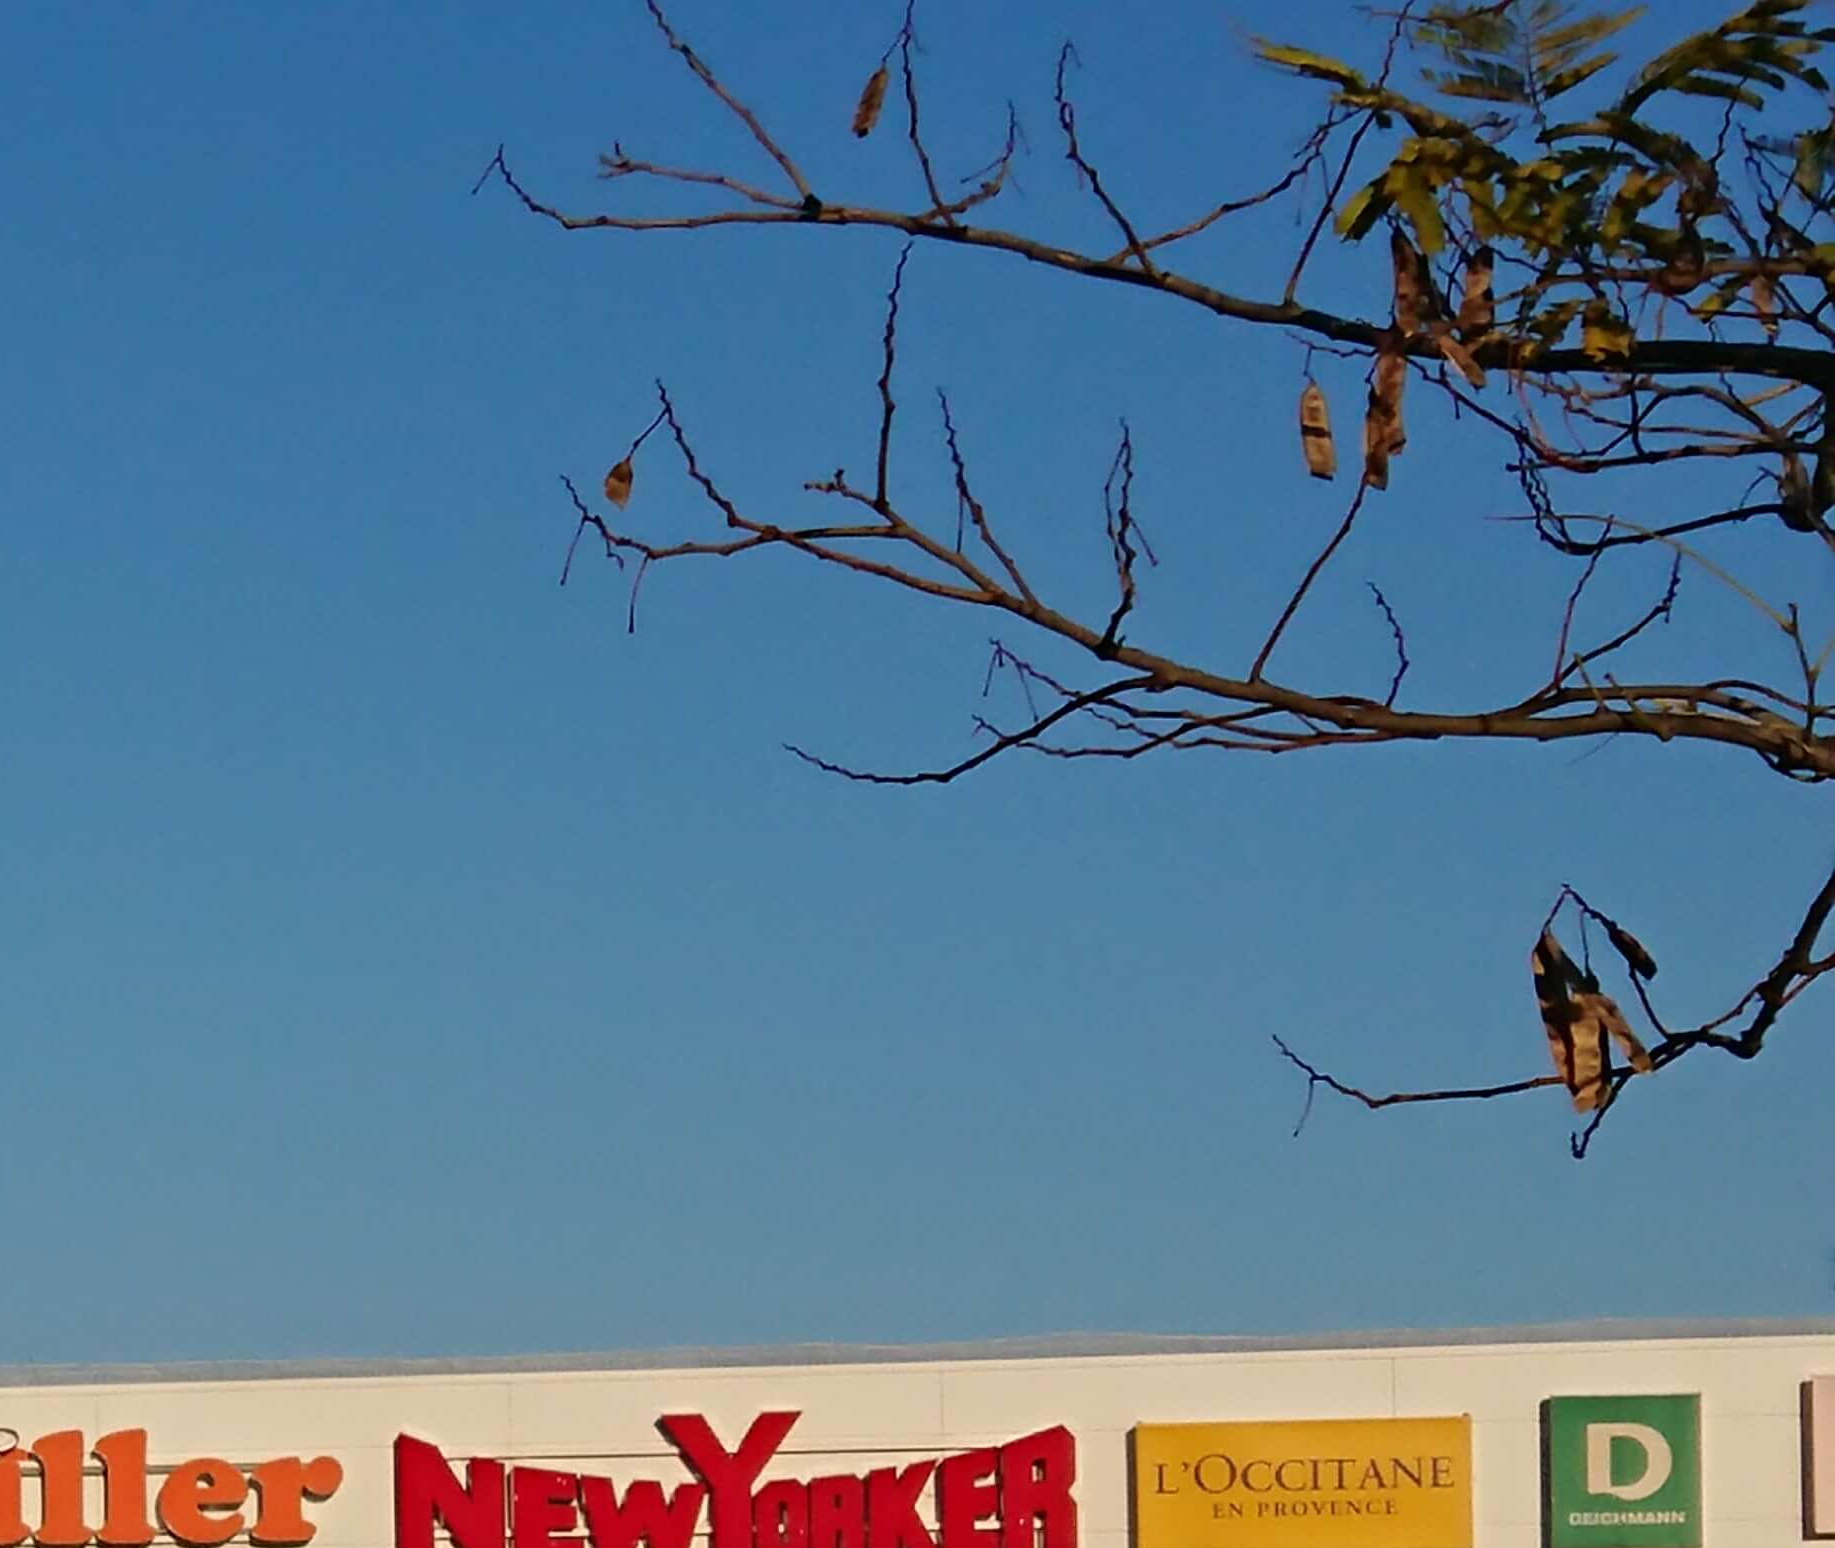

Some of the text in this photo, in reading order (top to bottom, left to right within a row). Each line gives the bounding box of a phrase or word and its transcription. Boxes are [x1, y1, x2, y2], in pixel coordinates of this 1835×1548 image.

[1154, 1453, 1456, 1496] L'OCCITANE
[1587, 1422, 1673, 1501] D
[1212, 1498, 1399, 1520] EN PROVENCE
[1568, 1510, 1686, 1527] DEICHMANN
